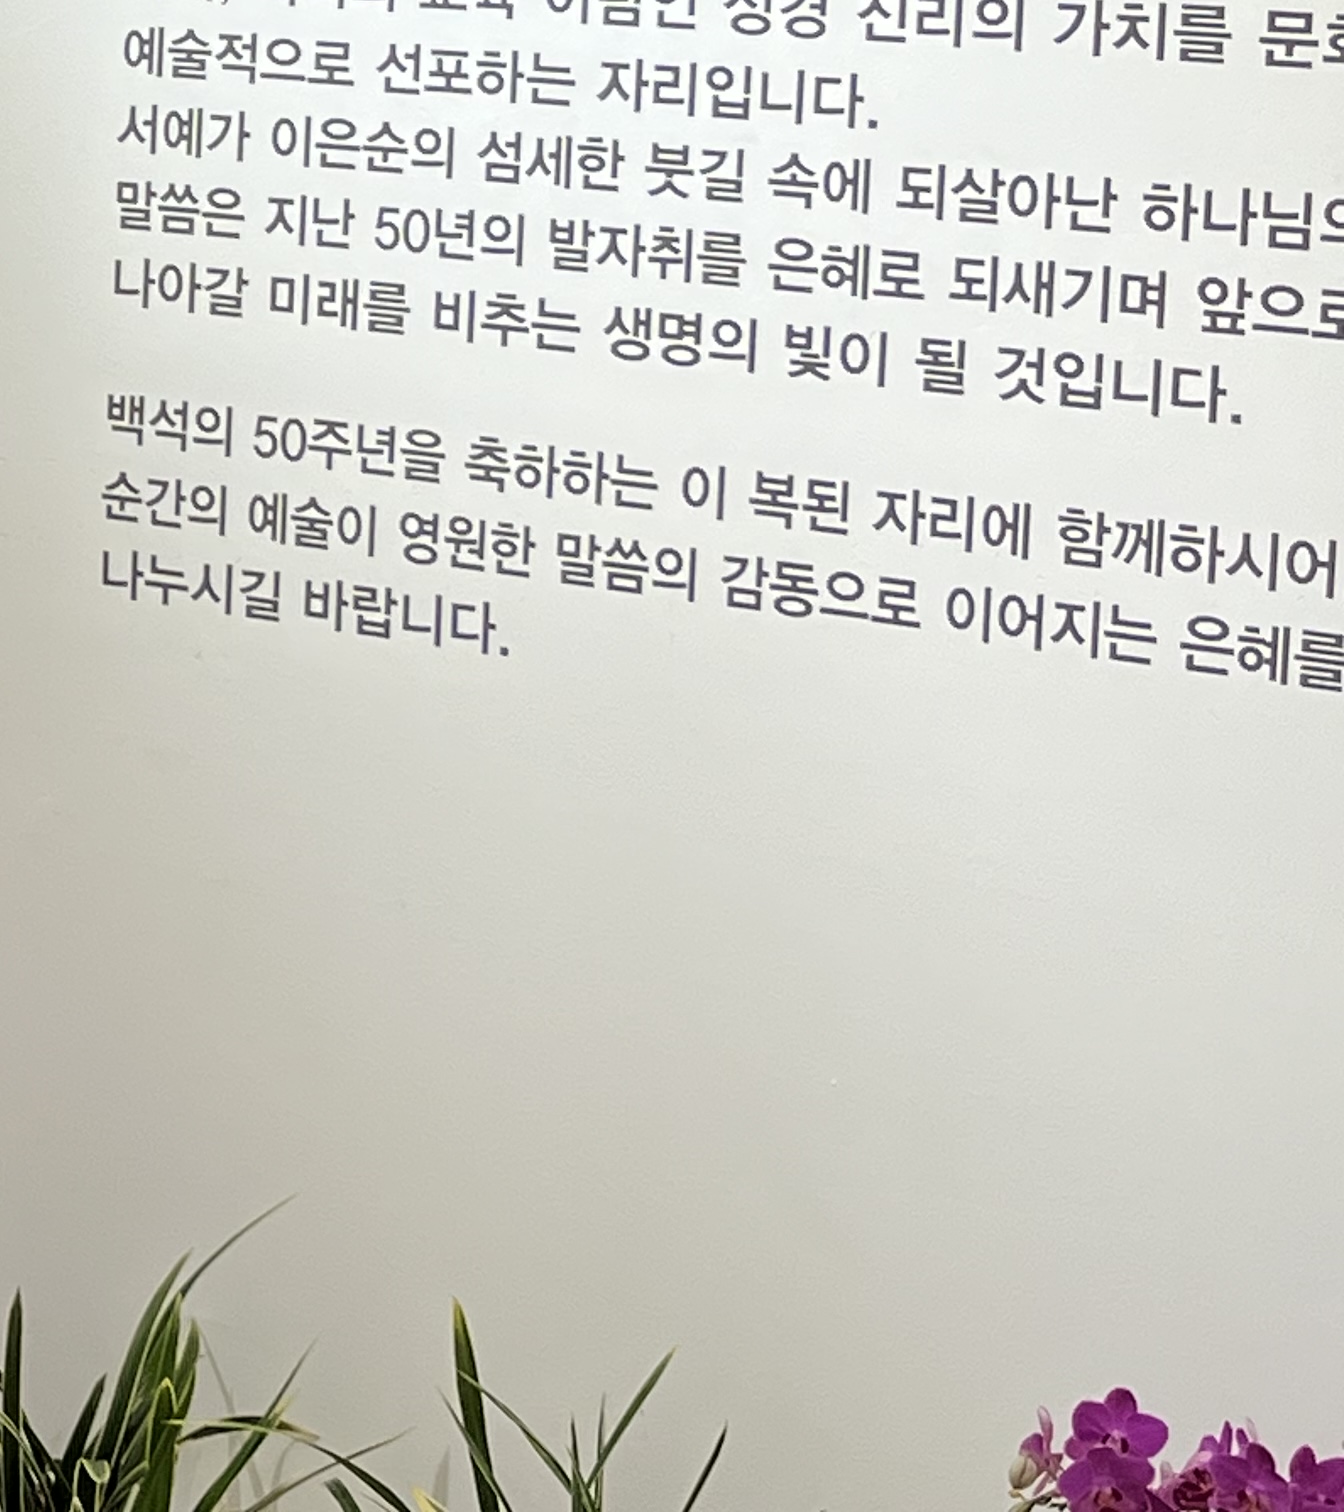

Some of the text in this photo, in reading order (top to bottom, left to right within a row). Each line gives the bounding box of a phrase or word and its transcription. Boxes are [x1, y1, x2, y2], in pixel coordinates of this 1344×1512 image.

[123, 26, 879, 130] 예술적으로 선포하는 자리입니다.
[1053, 0, 1233, 65] 가치를
[117, 104, 251, 163] 서예가
[271, 115, 455, 180] 이은순의
[477, 131, 626, 193] 섬세한
[644, 142, 745, 203] 붓길
[767, 152, 872, 215] 속에
[895, 163, 1119, 234] 되살아난
[116, 180, 246, 240] 말씀은
[264, 194, 356, 250] 지난
[374, 206, 525, 267] 50년의
[549, 218, 748, 288] 발자취를
[767, 237, 926, 301] 은혜로
[948, 255, 1167, 330] 되새기며
[113, 257, 1242, 425] 나아갈 미래를 비추는 생명의 빛이 될 것입니다.
[107, 393, 1338, 600] 백석의 50주년을 축하하는 이 복된 자리에 함께하시어
[101, 471, 1344, 693] 순간의 예술이 영원한 말씀의 감동으로 이어지는 은혜를
[102, 550, 510, 657] 나누시길 바랍니다.
